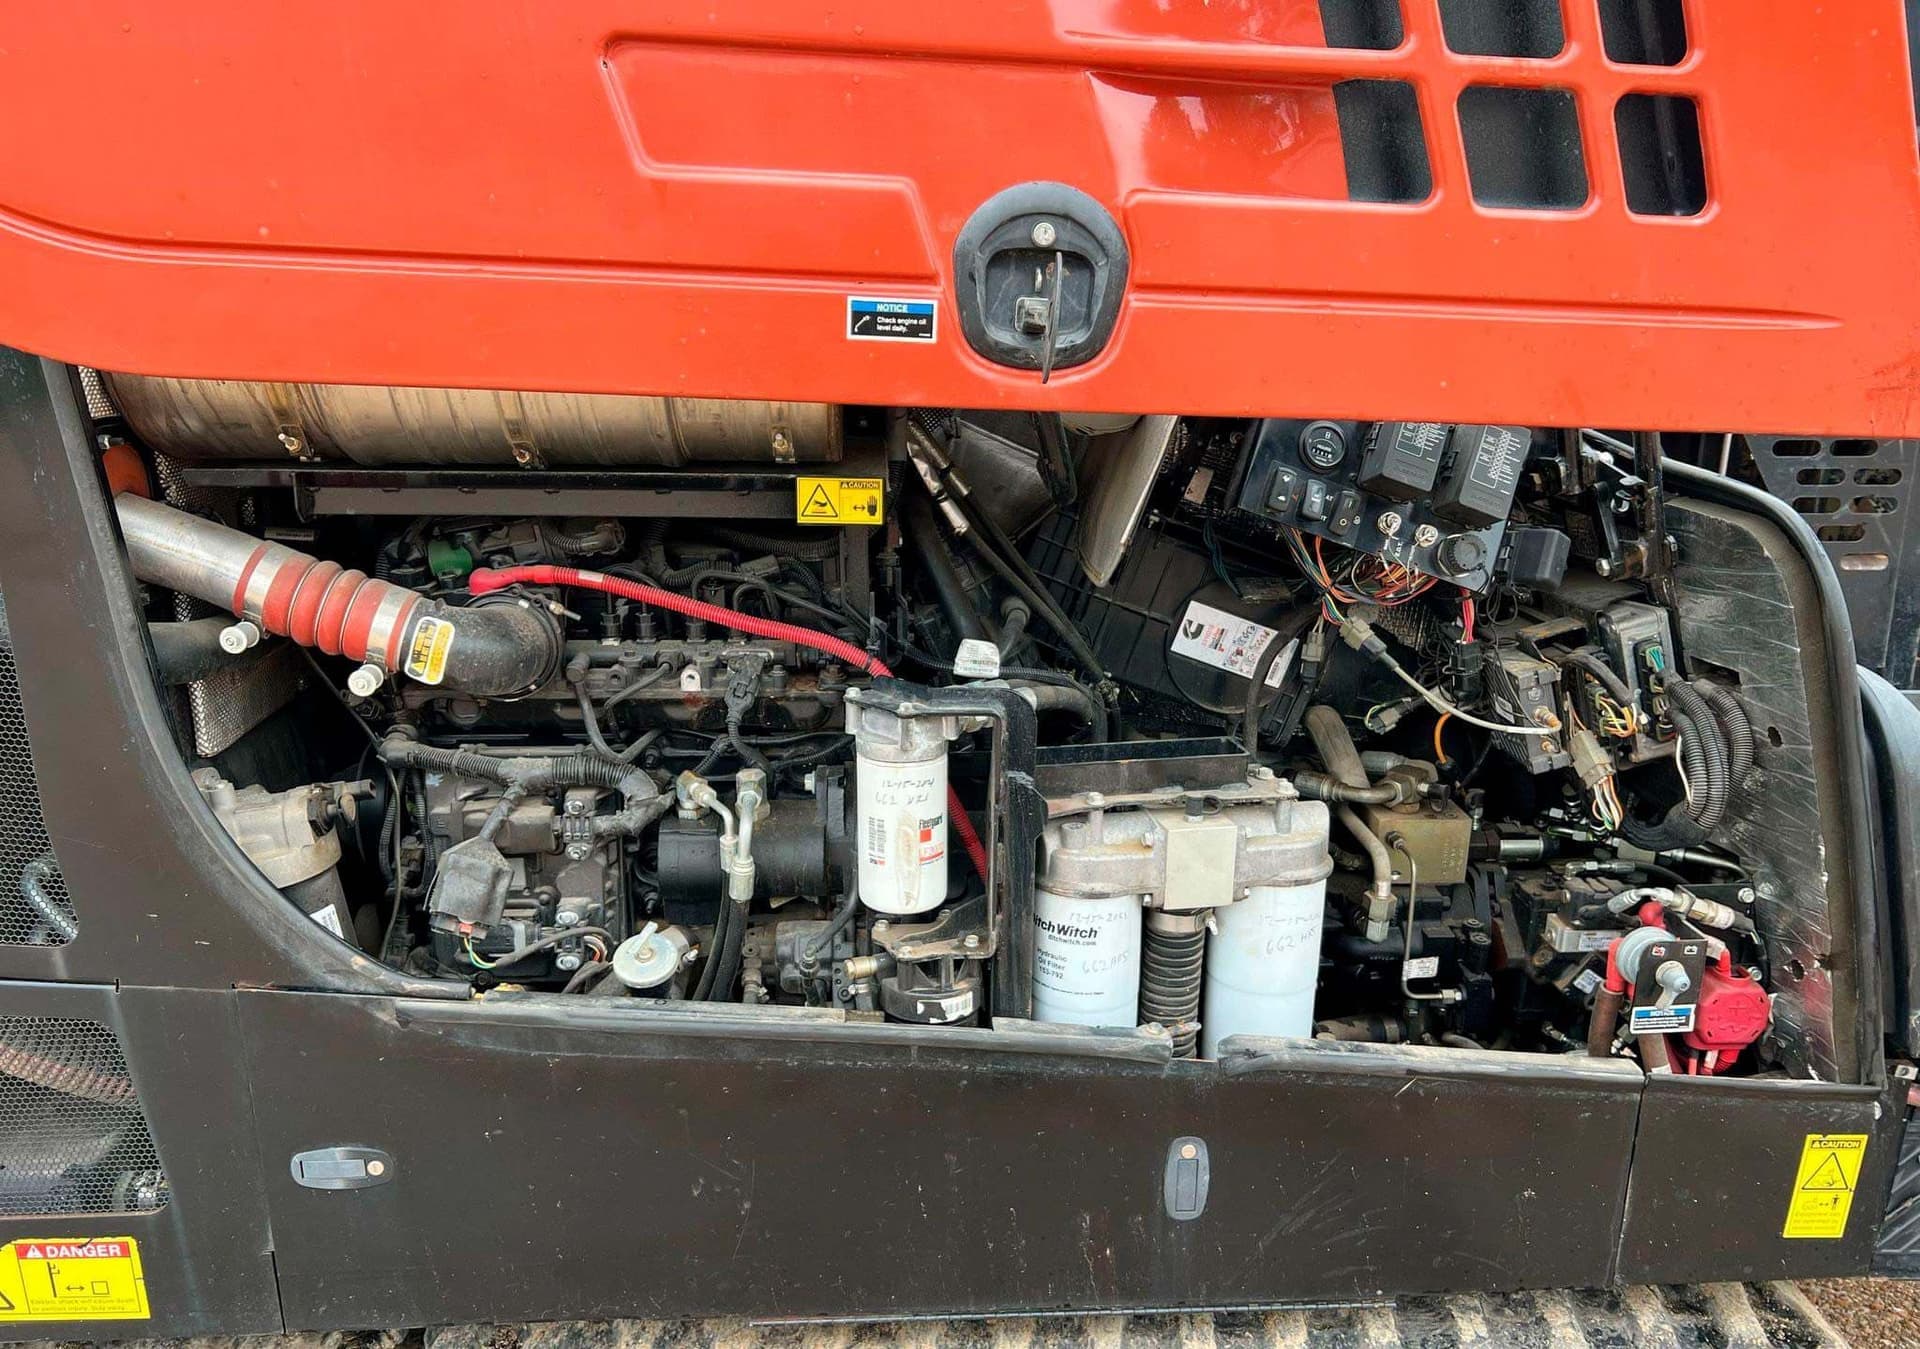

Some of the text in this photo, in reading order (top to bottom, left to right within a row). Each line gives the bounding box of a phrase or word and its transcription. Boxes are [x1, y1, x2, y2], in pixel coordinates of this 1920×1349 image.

[876, 303, 908, 313] NOTICE
[877, 316, 896, 324] Check
[897, 318, 917, 326] engine
[848, 481, 879, 489] CAUTION
[1047, 959, 1066, 972] Filter
[1820, 1140, 1861, 1149] CAUTION
[45, 1243, 122, 1258] DANGER
